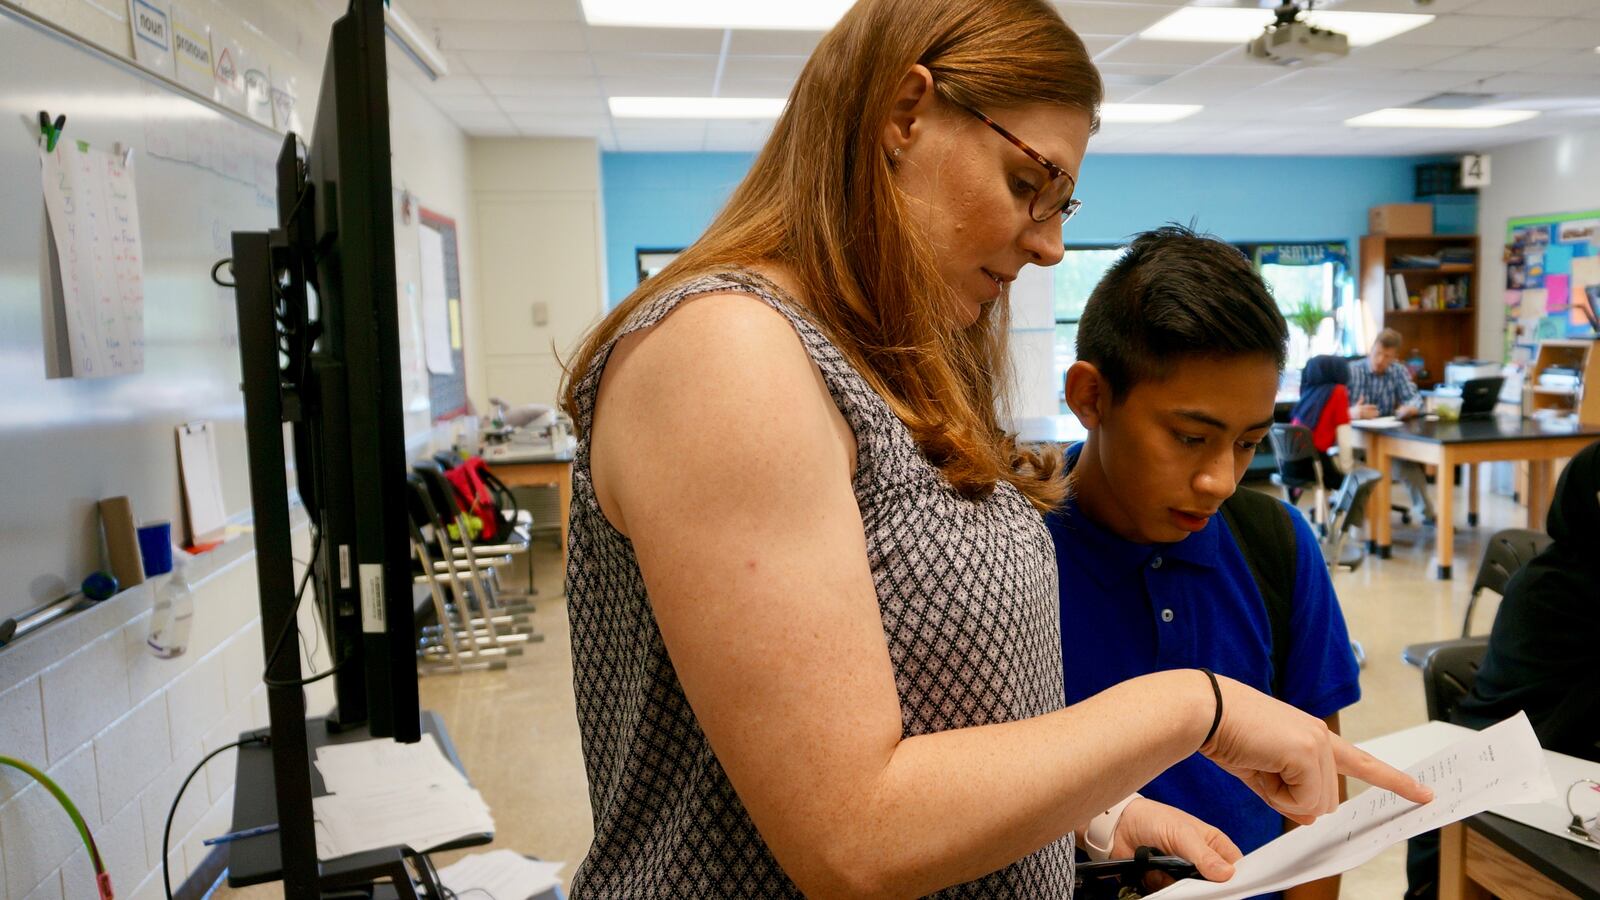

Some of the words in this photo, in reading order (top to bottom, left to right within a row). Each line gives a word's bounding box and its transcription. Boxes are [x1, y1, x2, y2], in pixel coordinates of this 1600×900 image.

[140, 13, 163, 39] noun
[176, 34, 209, 64] pronoun
[1468, 158, 1483, 180] 4
[1278, 245, 1325, 259] SEATTLE
